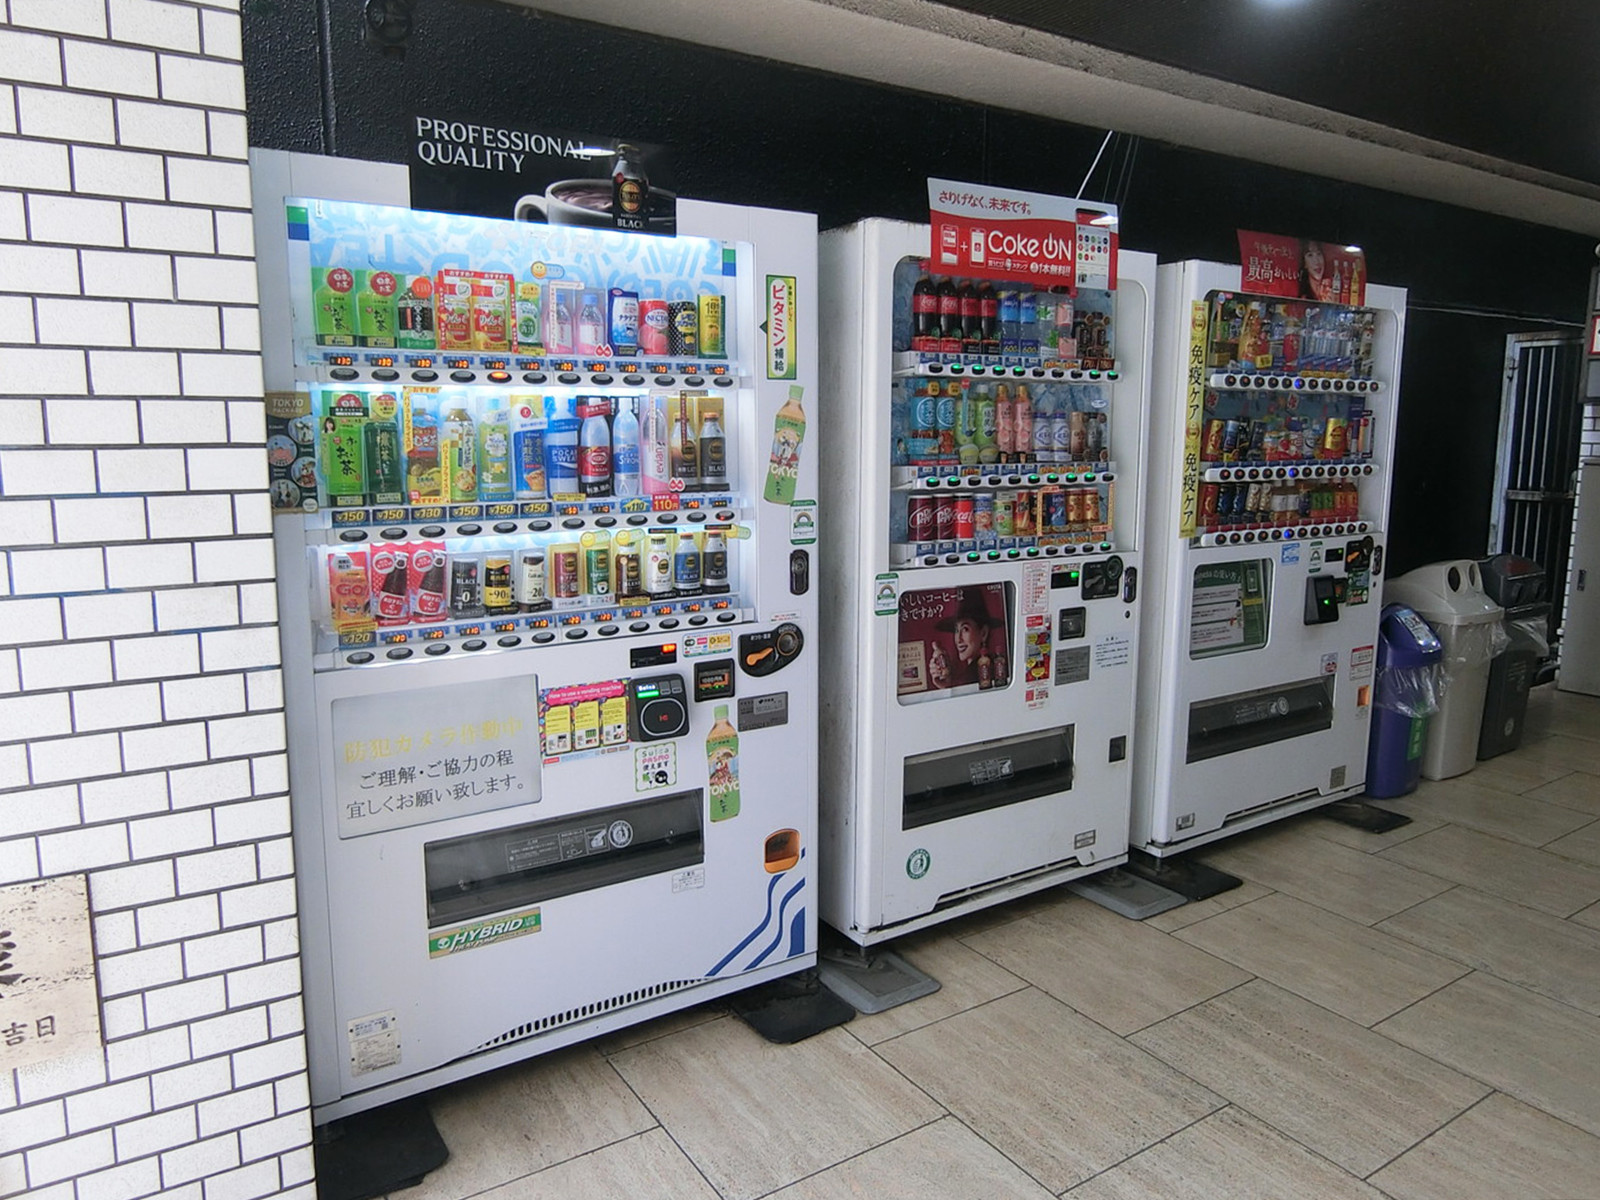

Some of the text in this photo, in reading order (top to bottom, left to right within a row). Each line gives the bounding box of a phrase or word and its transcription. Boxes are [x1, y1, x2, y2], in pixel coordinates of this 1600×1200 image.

[416, 116, 592, 161] PROFESSIONAL
[418, 140, 525, 174] QUALITY
[938, 190, 1032, 216] さりげなく、未来です。
[987, 229, 1072, 261] Coke ON
[773, 284, 786, 372] ビタミン補給
[1188, 344, 1204, 419] 免疫ケア
[272, 398, 304, 408] TOKYO
[655, 447, 664, 474] evian
[654, 499, 679, 510] 110円
[1182, 452, 1198, 527] 免疫ケア
[343, 716, 524, 765] 防犯カメラ作動中
[642, 748, 669, 758] Suica
[359, 749, 514, 790] ご理解・ご協力の程
[642, 754, 670, 764] PASMO
[346, 773, 525, 820] 宜しくお願い致します。
[450, 918, 524, 953] HYBRID
[1, 1015, 56, 1047] 吉日
